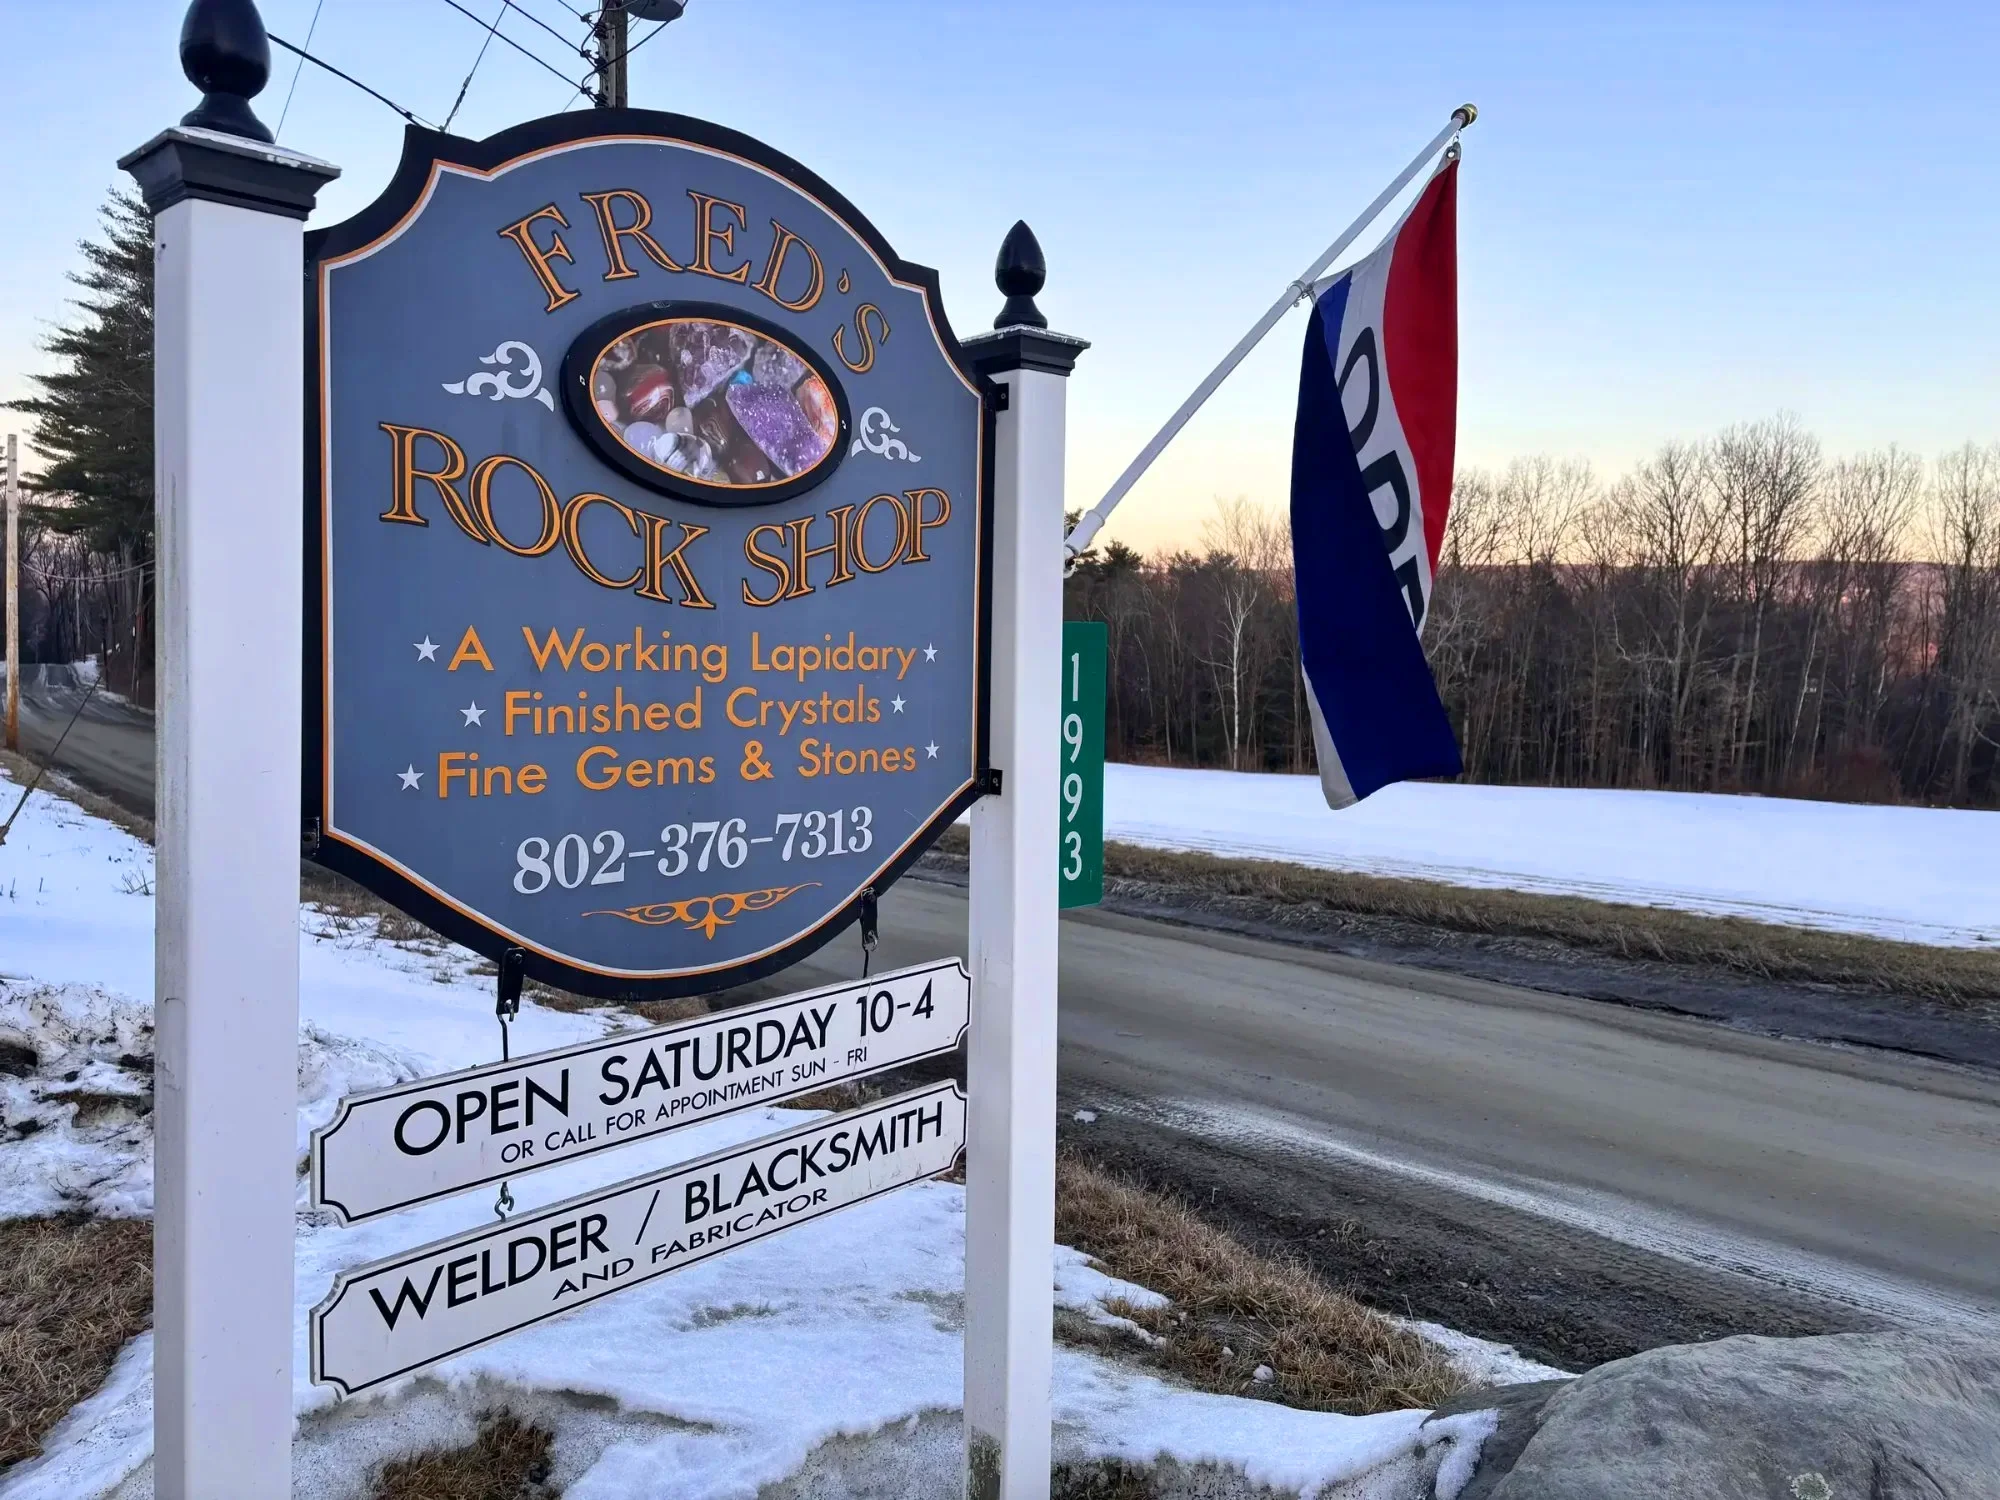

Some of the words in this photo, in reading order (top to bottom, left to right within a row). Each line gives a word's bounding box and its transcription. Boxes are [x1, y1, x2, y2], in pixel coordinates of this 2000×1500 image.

[498, 187, 892, 374] FRED'S
[379, 422, 717, 610] ROCK
[741, 487, 952, 607] SHOP
[447, 624, 494, 672] A
[522, 626, 728, 683] Working
[751, 631, 917, 682] Lapidary
[504, 687, 702, 736] Finished
[726, 684, 881, 735] Crystals
[438, 751, 548, 798] Fine
[576, 746, 716, 790] Gems
[740, 740, 774, 781] &
[798, 738, 917, 777] Stones
[1063, 652, 1083, 881] 1993
[513, 806, 874, 894] 802-376-7313
[393, 1069, 571, 1157] OPEN
[598, 1003, 837, 1106] SATURDAY
[858, 979, 935, 1038] 10-4
[500, 1142, 536, 1164] OR
[544, 1124, 599, 1152] CALL
[606, 1112, 646, 1135] FOR
[655, 1069, 784, 1120] APPOINTMENT
[791, 1057, 826, 1081] SUN
[847, 1046, 867, 1066] FRI
[369, 1213, 609, 1332] WELDER
[684, 1101, 944, 1226] BLACKSMITH
[552, 1257, 636, 1301] AND
[651, 1187, 828, 1261] FABRICATOR
